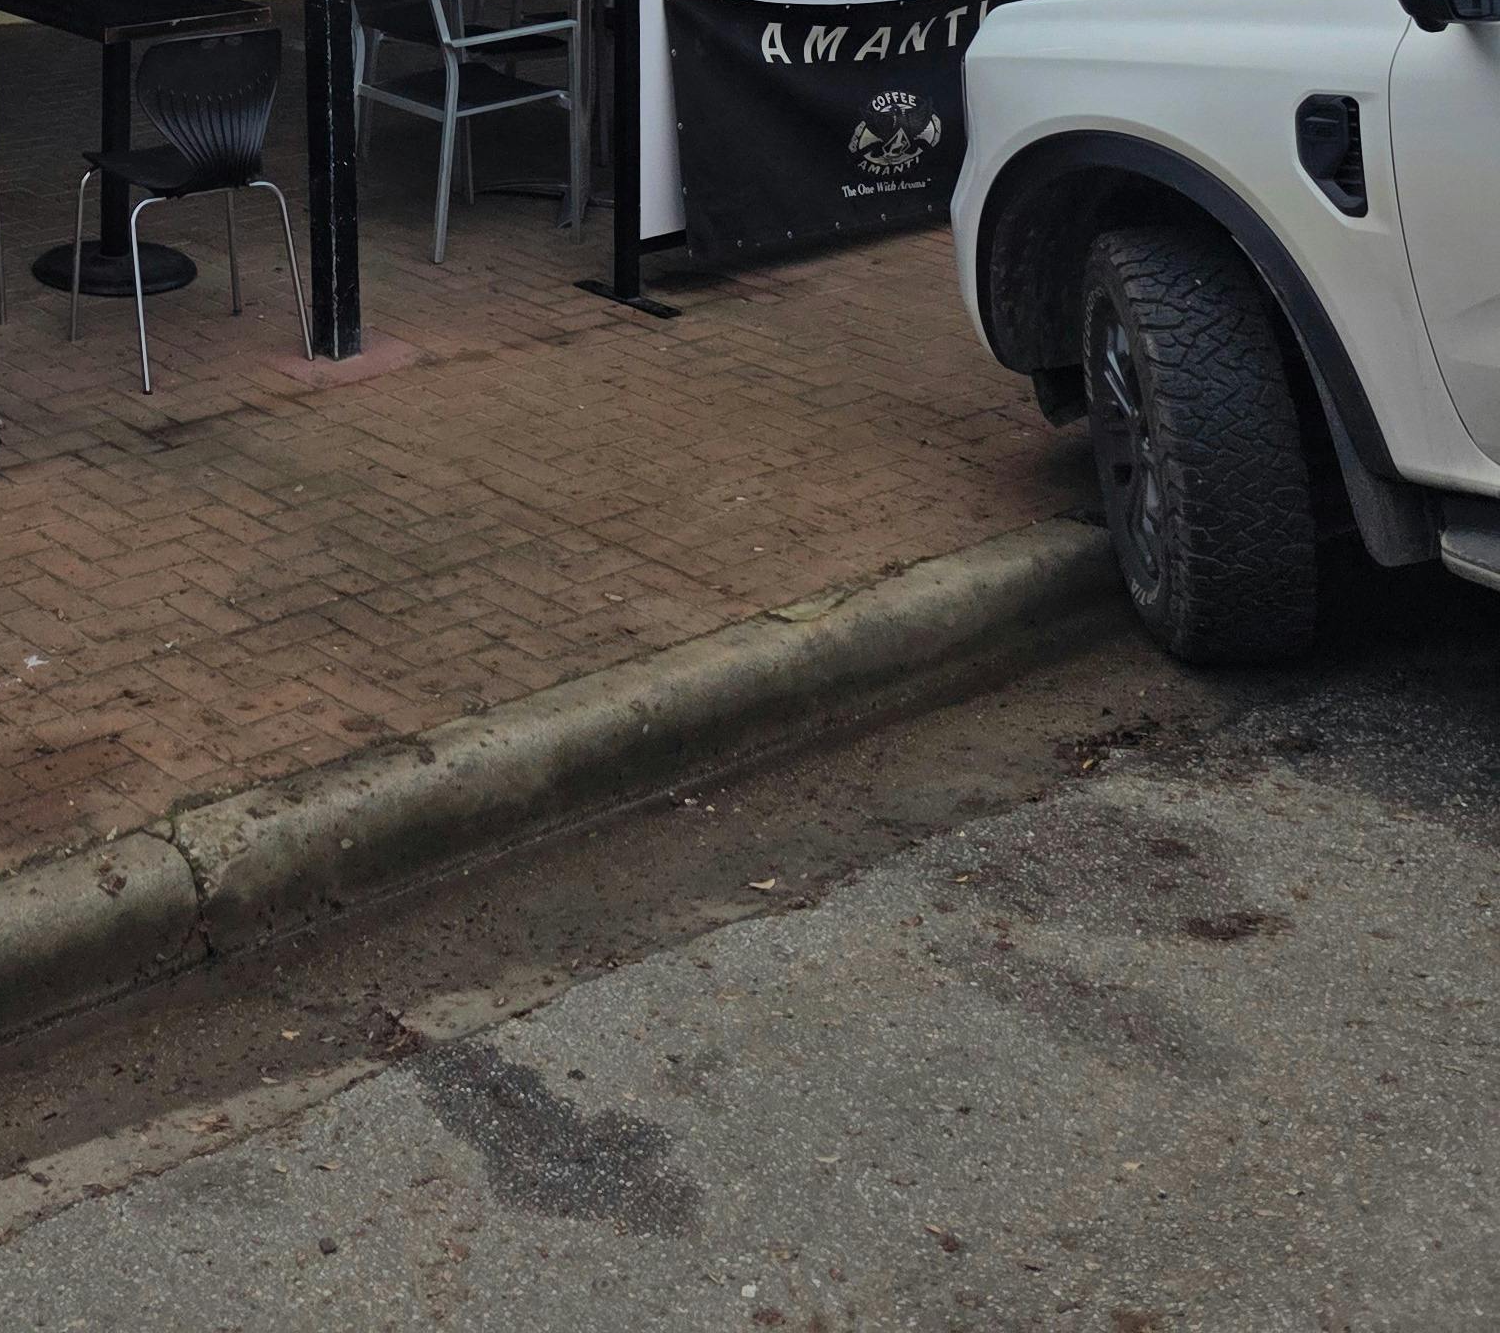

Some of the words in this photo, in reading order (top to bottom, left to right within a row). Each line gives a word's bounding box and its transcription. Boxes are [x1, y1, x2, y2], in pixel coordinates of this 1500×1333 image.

[871, 91, 917, 112] COFFEE
[857, 156, 920, 176] AMANTI
[841, 185, 857, 198] The
[857, 183, 875, 196] One
[876, 180, 897, 193] With
